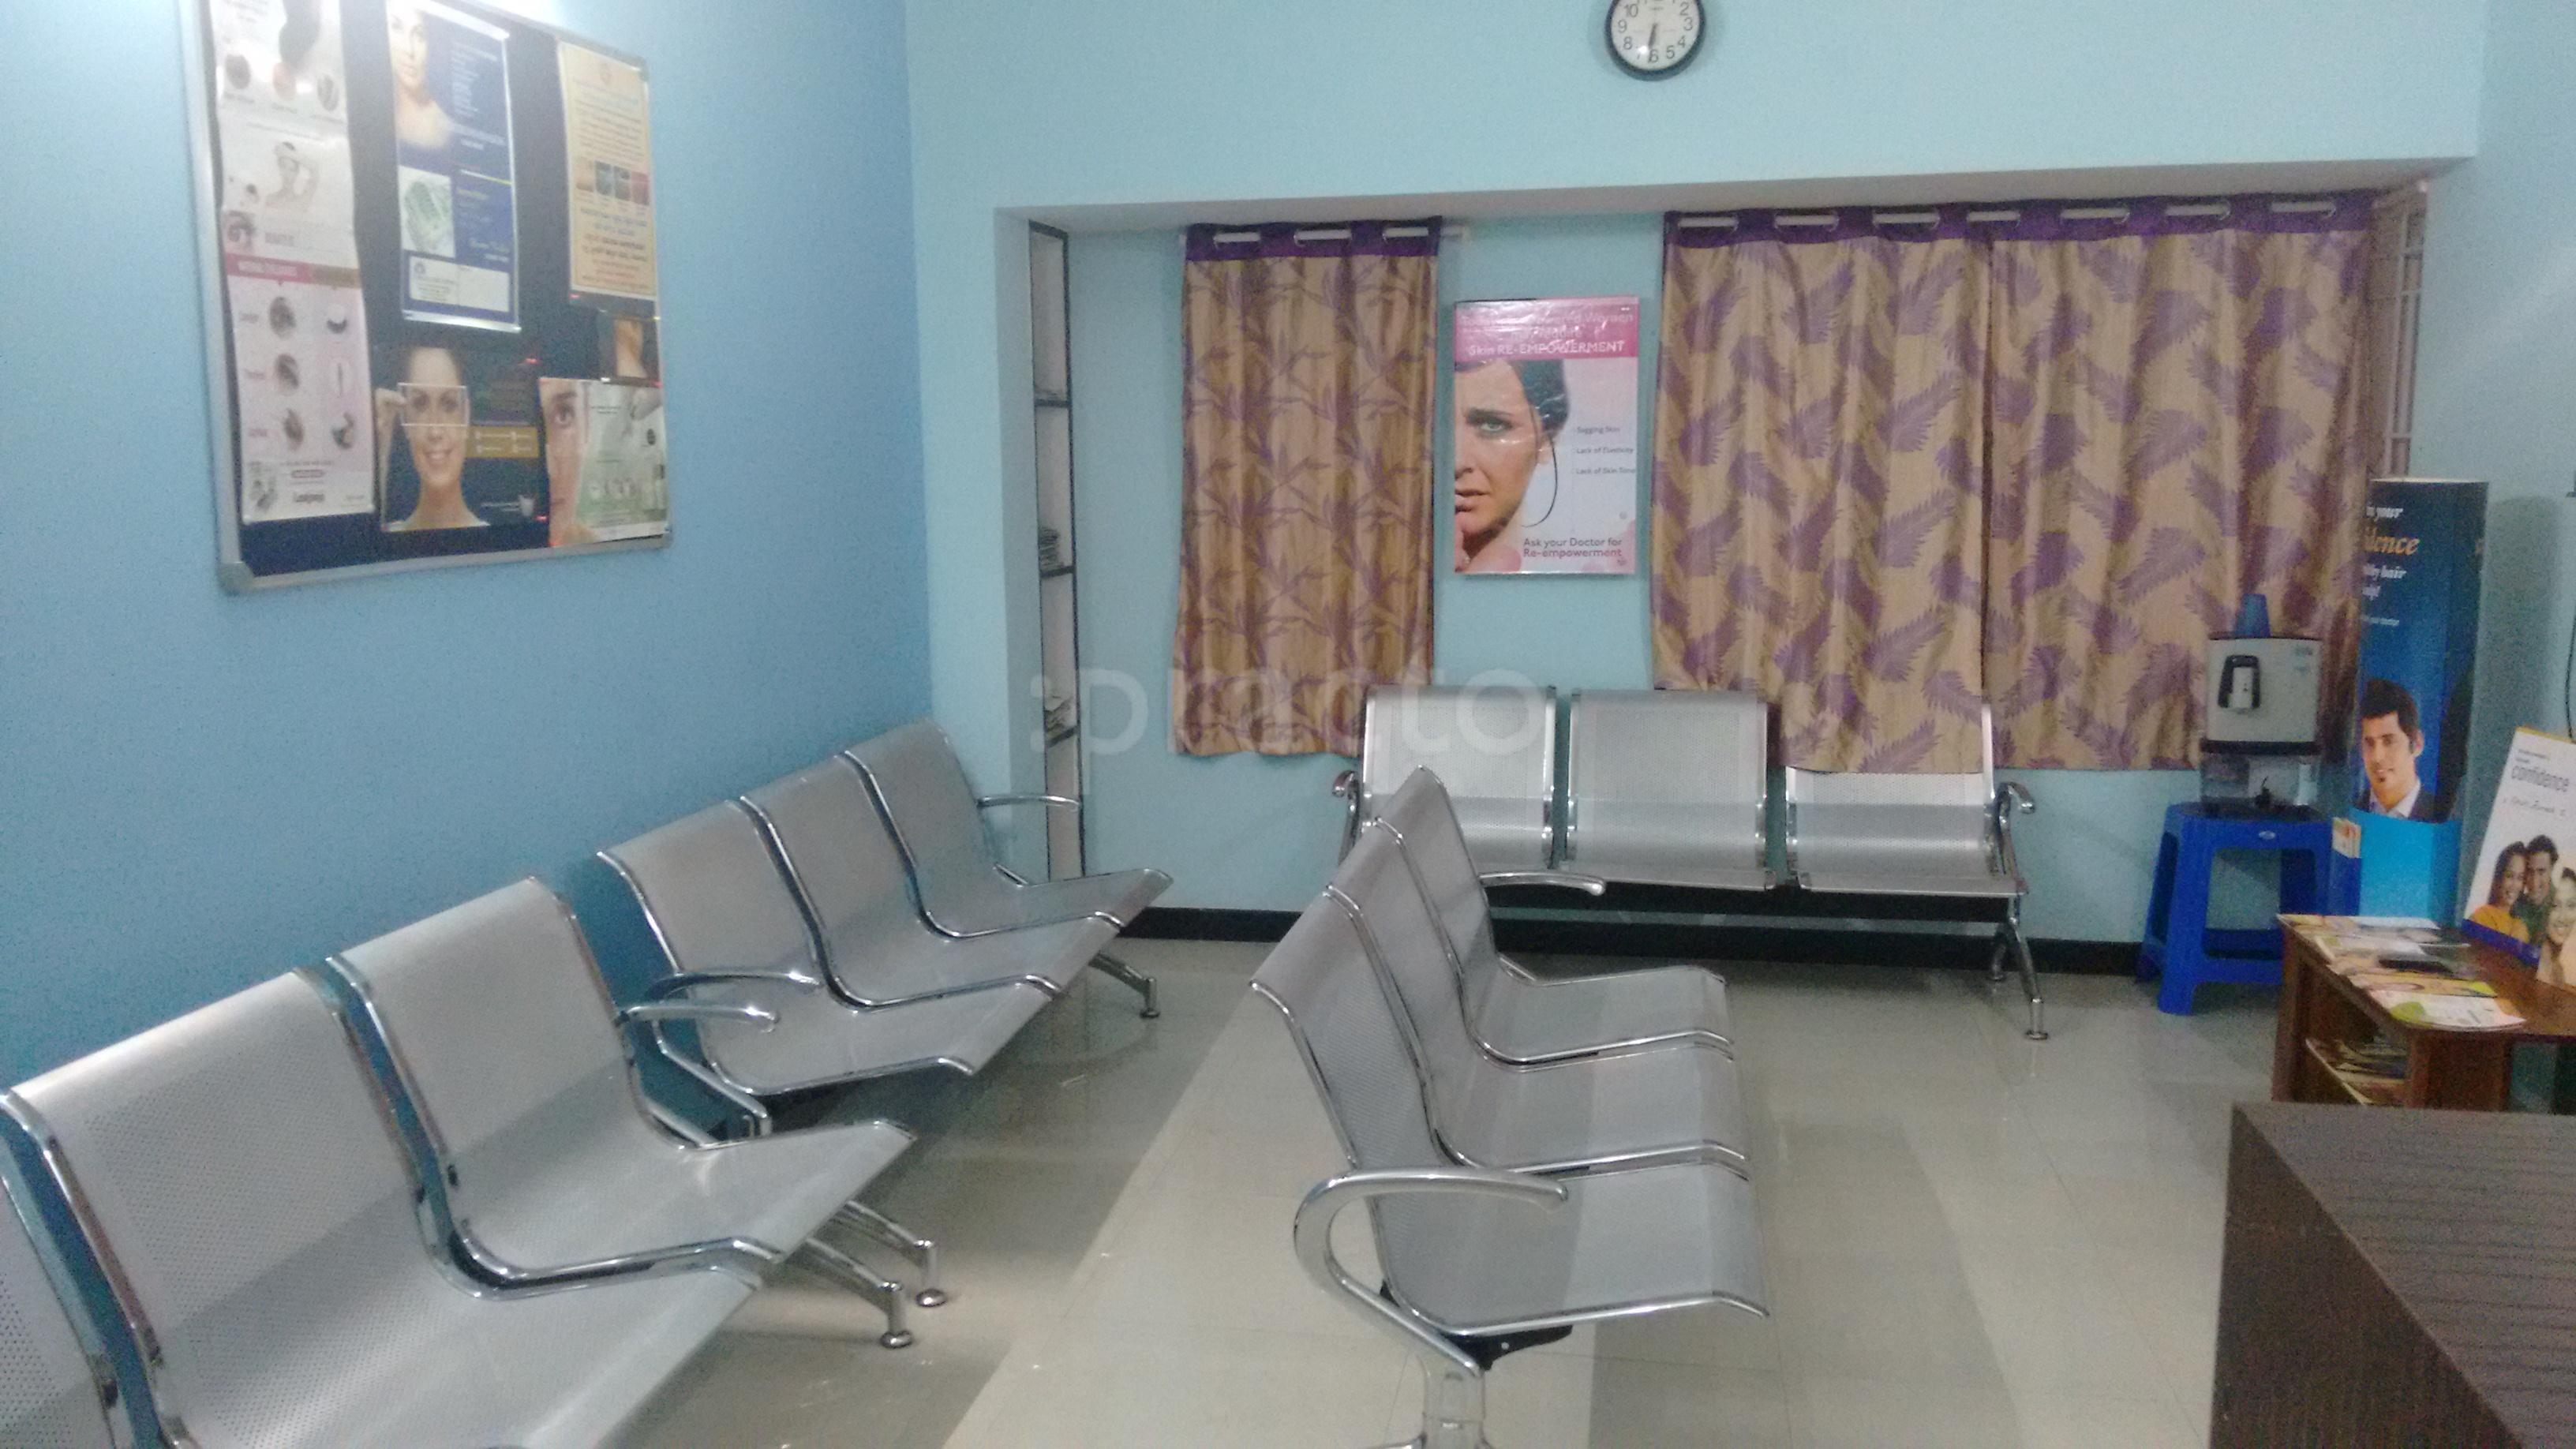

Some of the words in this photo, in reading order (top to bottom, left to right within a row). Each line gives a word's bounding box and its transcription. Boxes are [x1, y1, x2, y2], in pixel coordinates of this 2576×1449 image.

[1624, 3, 1638, 17] 10
[1679, 2, 1690, 16] 2
[1618, 19, 1627, 33] 9
[1683, 16, 1693, 31] 3
[1623, 36, 1633, 50] 8
[1677, 35, 1686, 48] 4
[1649, 49, 1658, 63] 6
[1666, 45, 1675, 59] 5
[1523, 538, 1541, 547] Ask
[1544, 540, 1567, 549] your
[1570, 537, 1605, 546] Doctor
[1608, 537, 1622, 546] for
[1523, 549, 1622, 559] Re-empowerment
[2511, 765, 2570, 792] confidence
